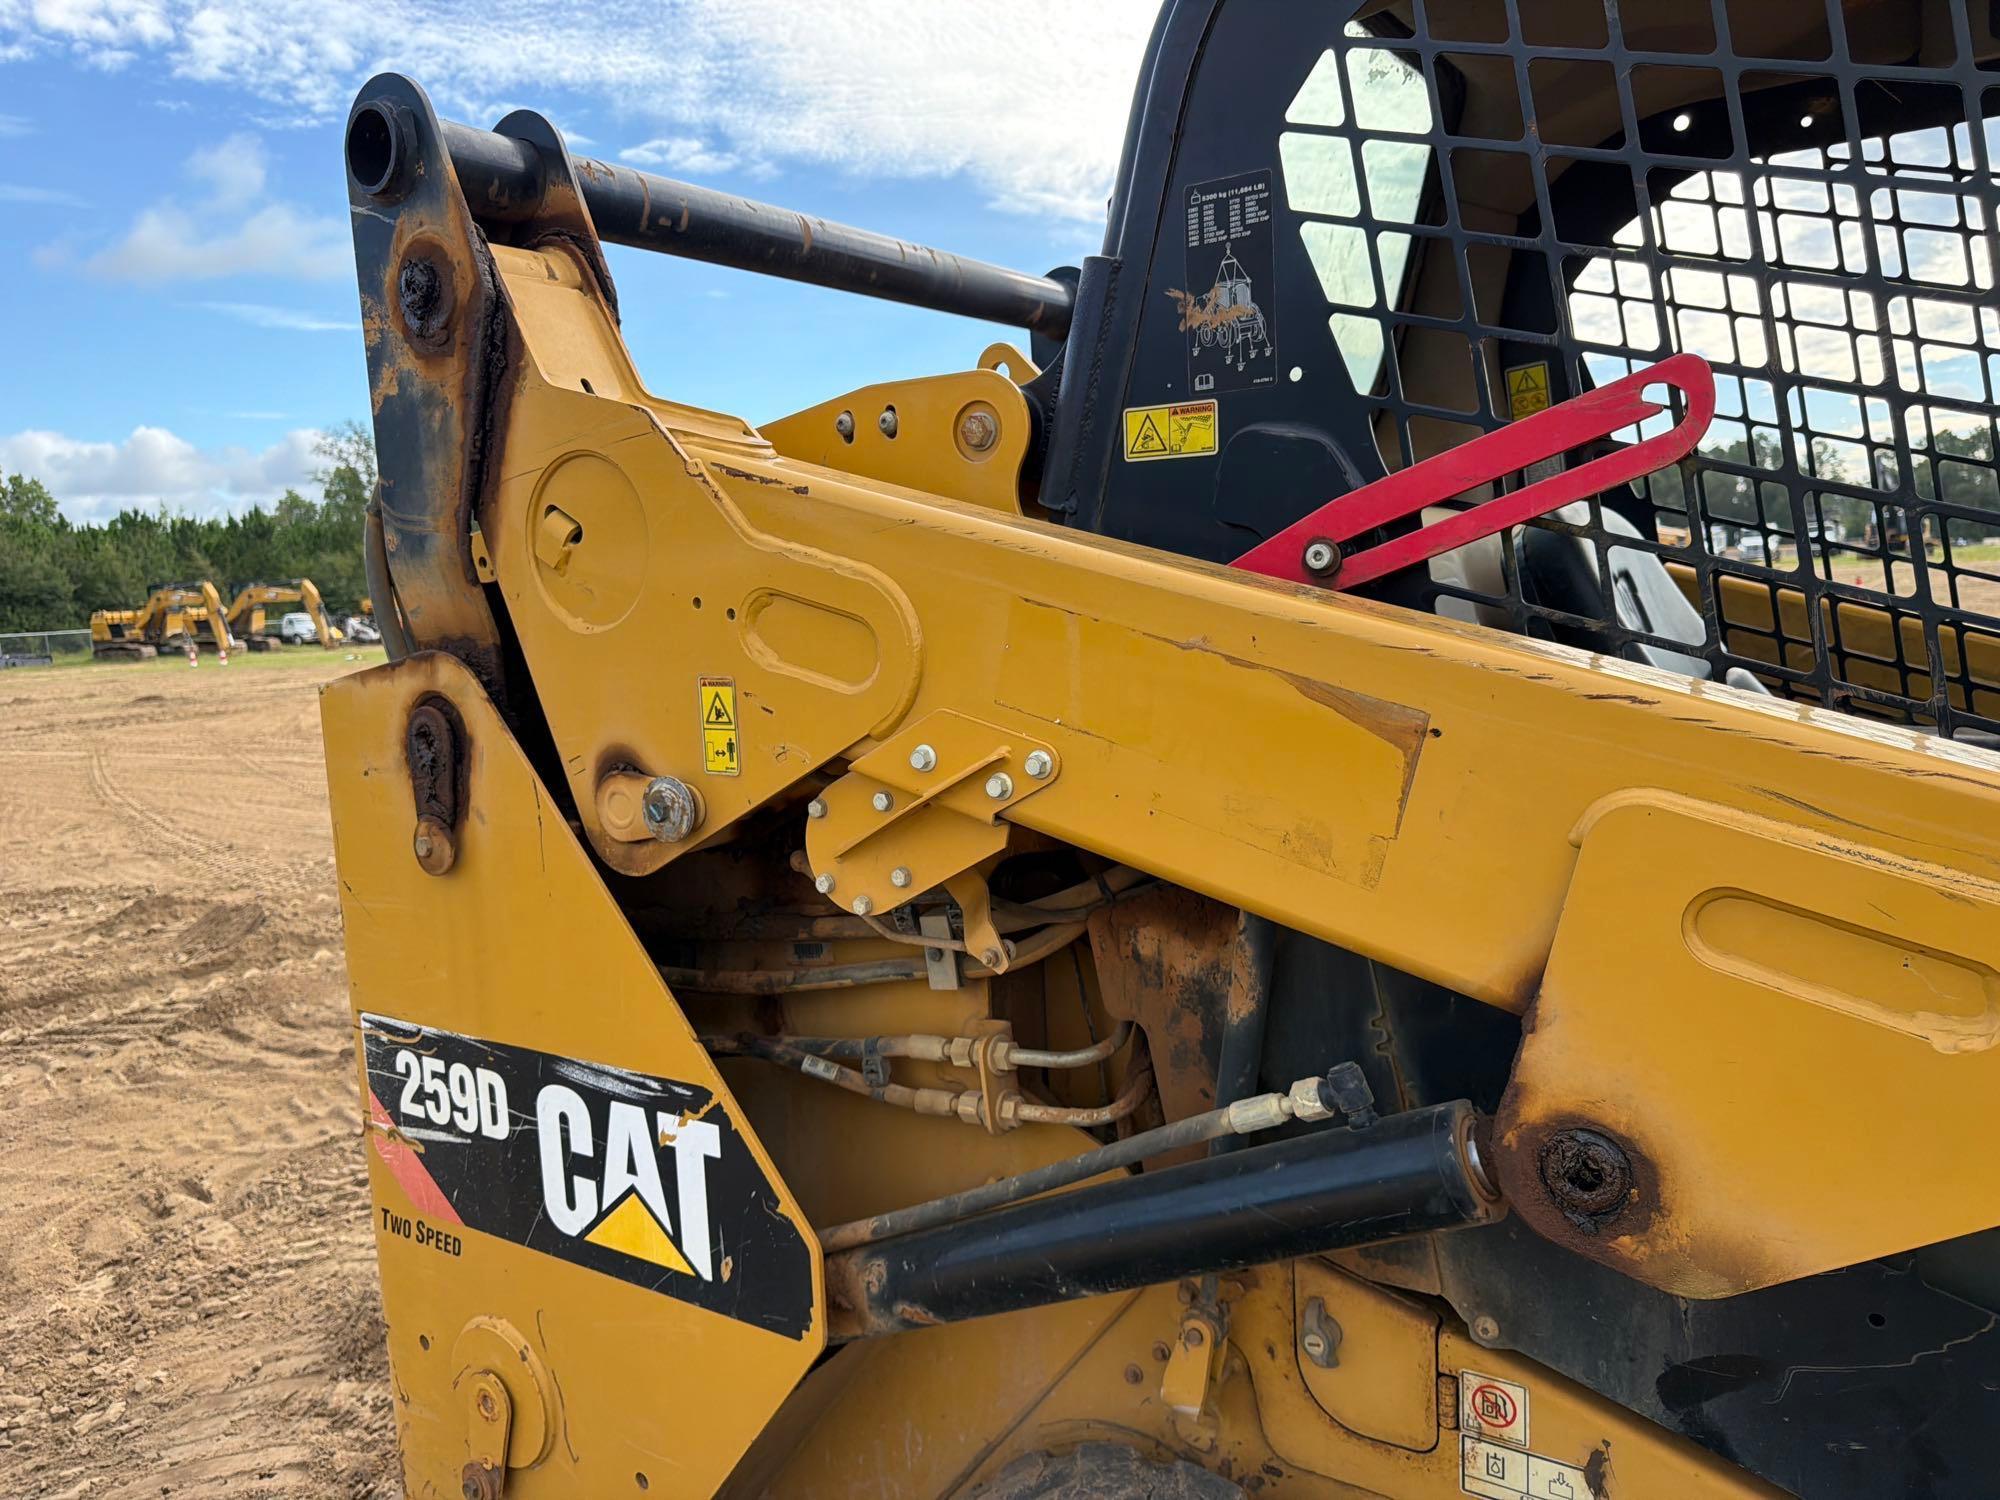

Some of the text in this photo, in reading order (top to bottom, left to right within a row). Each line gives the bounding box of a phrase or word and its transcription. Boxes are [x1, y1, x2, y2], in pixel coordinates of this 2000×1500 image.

[1180, 405, 1212, 415] WARNING
[395, 1050, 510, 1140] 259D
[536, 1084, 721, 1281] CAT
